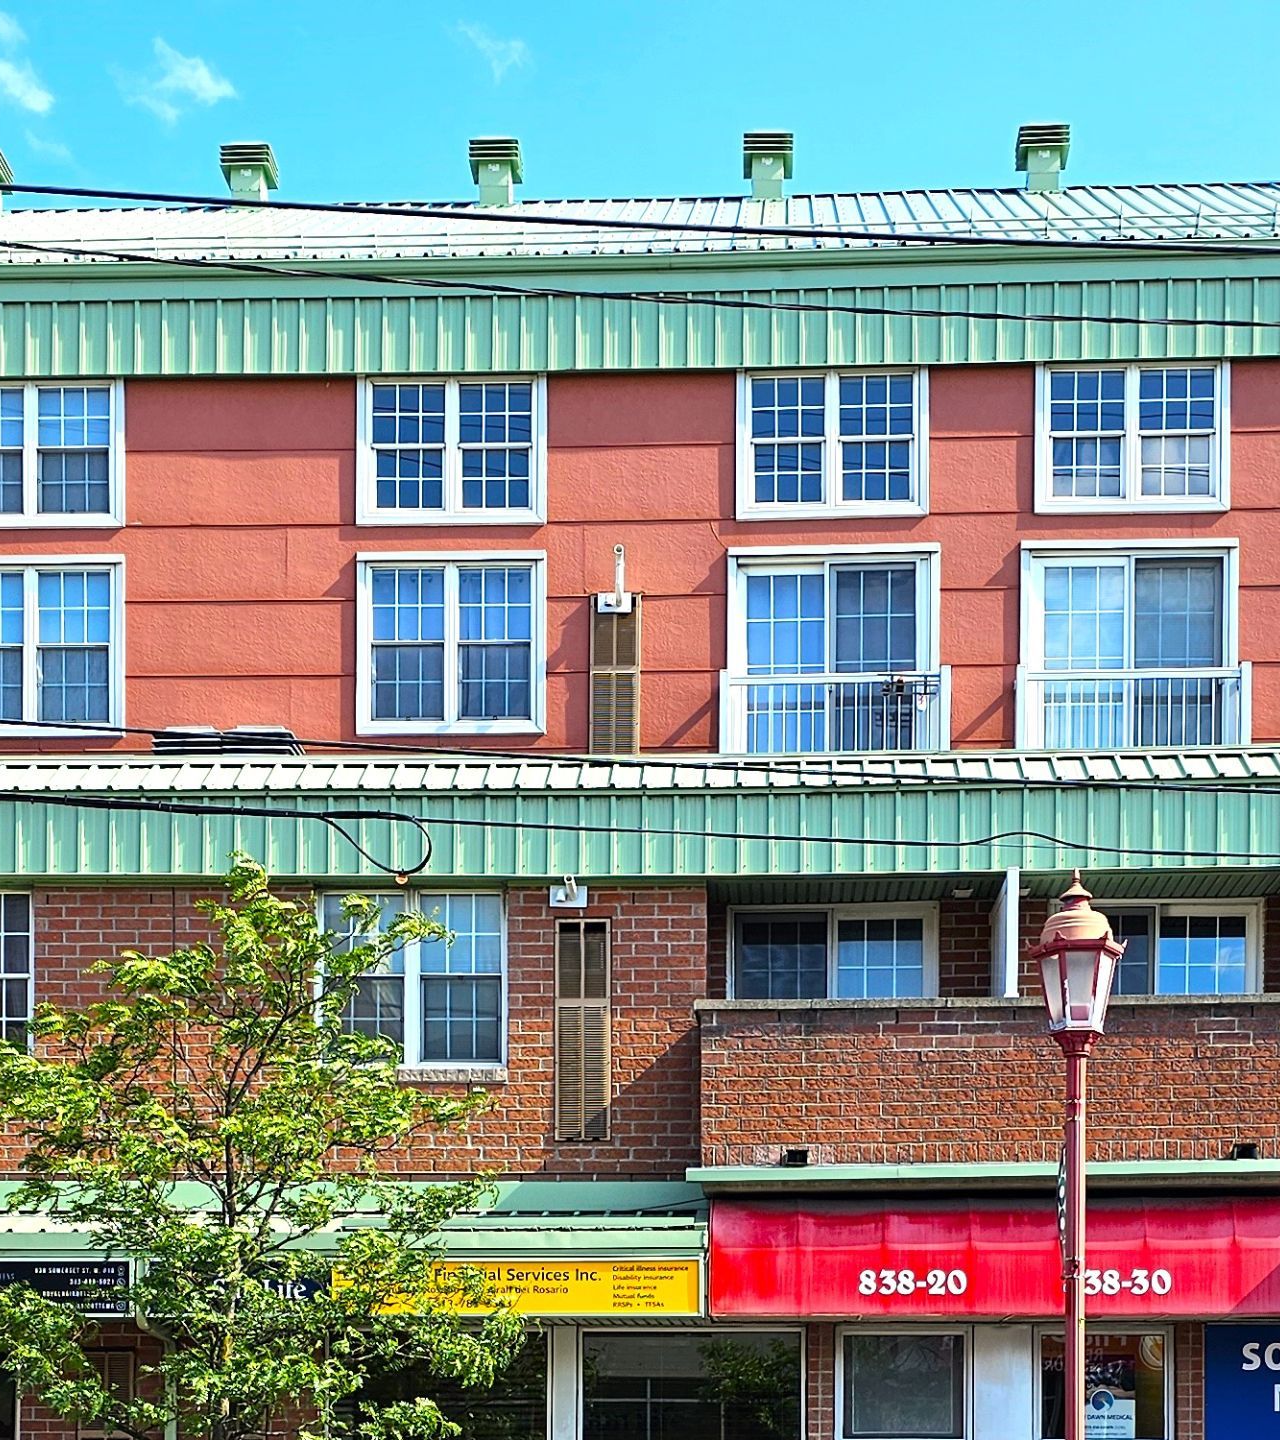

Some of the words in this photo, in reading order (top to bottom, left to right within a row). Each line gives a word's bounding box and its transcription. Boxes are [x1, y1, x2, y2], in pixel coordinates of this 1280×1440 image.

[506, 1267, 570, 1282] Services
[575, 1267, 602, 1282] Inc.
[612, 1274, 641, 1282] Disability
[858, 1268, 968, 1295] 838-20
[1082, 1268, 1172, 1295] 38-30
[532, 1284, 569, 1294] Rosario
